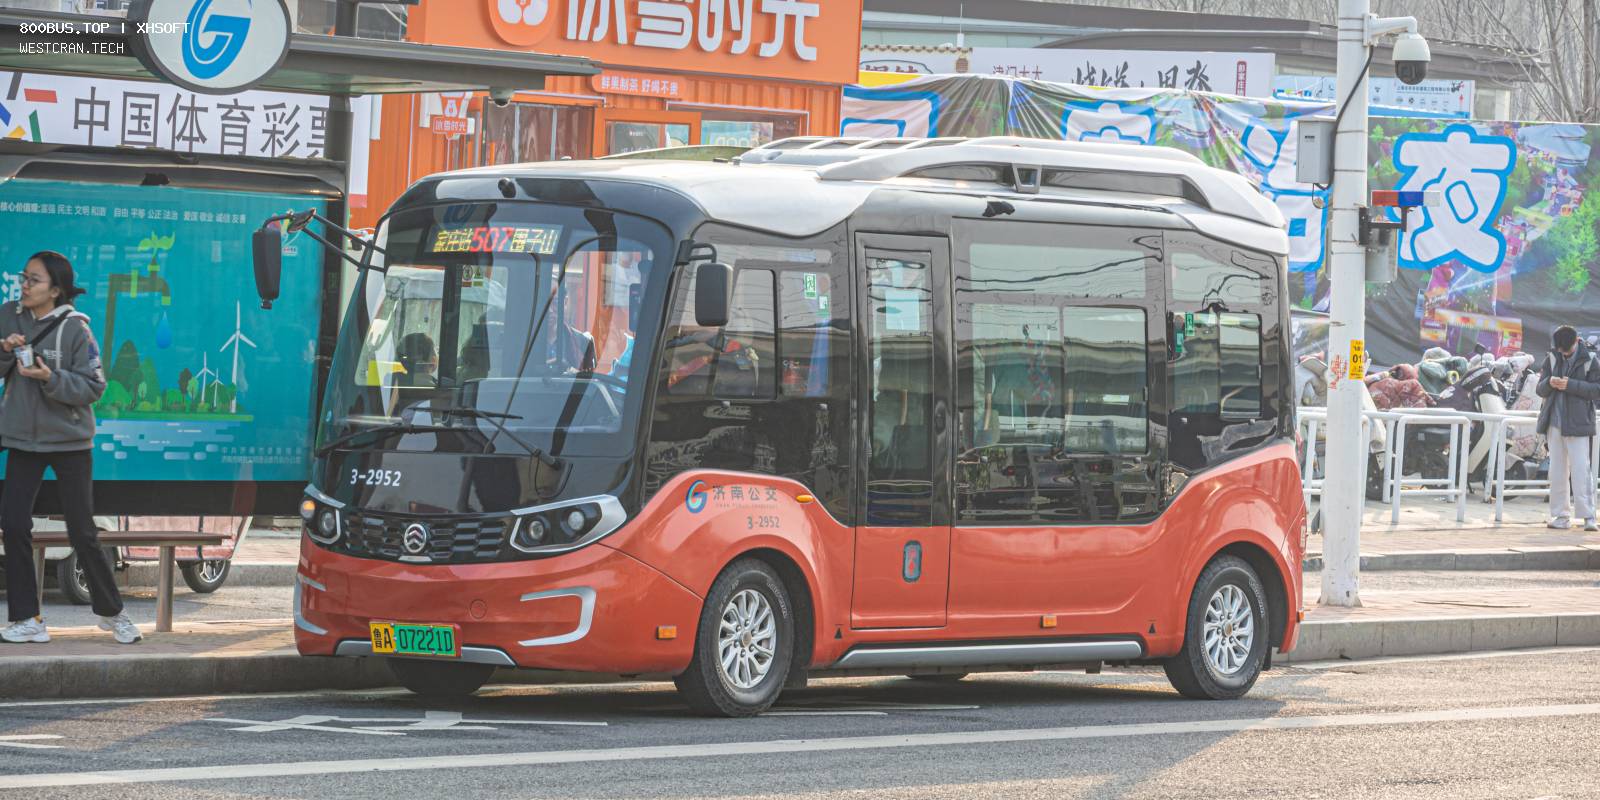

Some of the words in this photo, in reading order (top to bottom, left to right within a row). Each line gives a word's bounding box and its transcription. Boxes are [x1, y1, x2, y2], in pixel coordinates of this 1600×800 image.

[469, 227, 515, 252] 507
[350, 468, 402, 487] 3-2952
[712, 485, 777, 501] 济南公交
[747, 514, 780, 529] 3-2952
